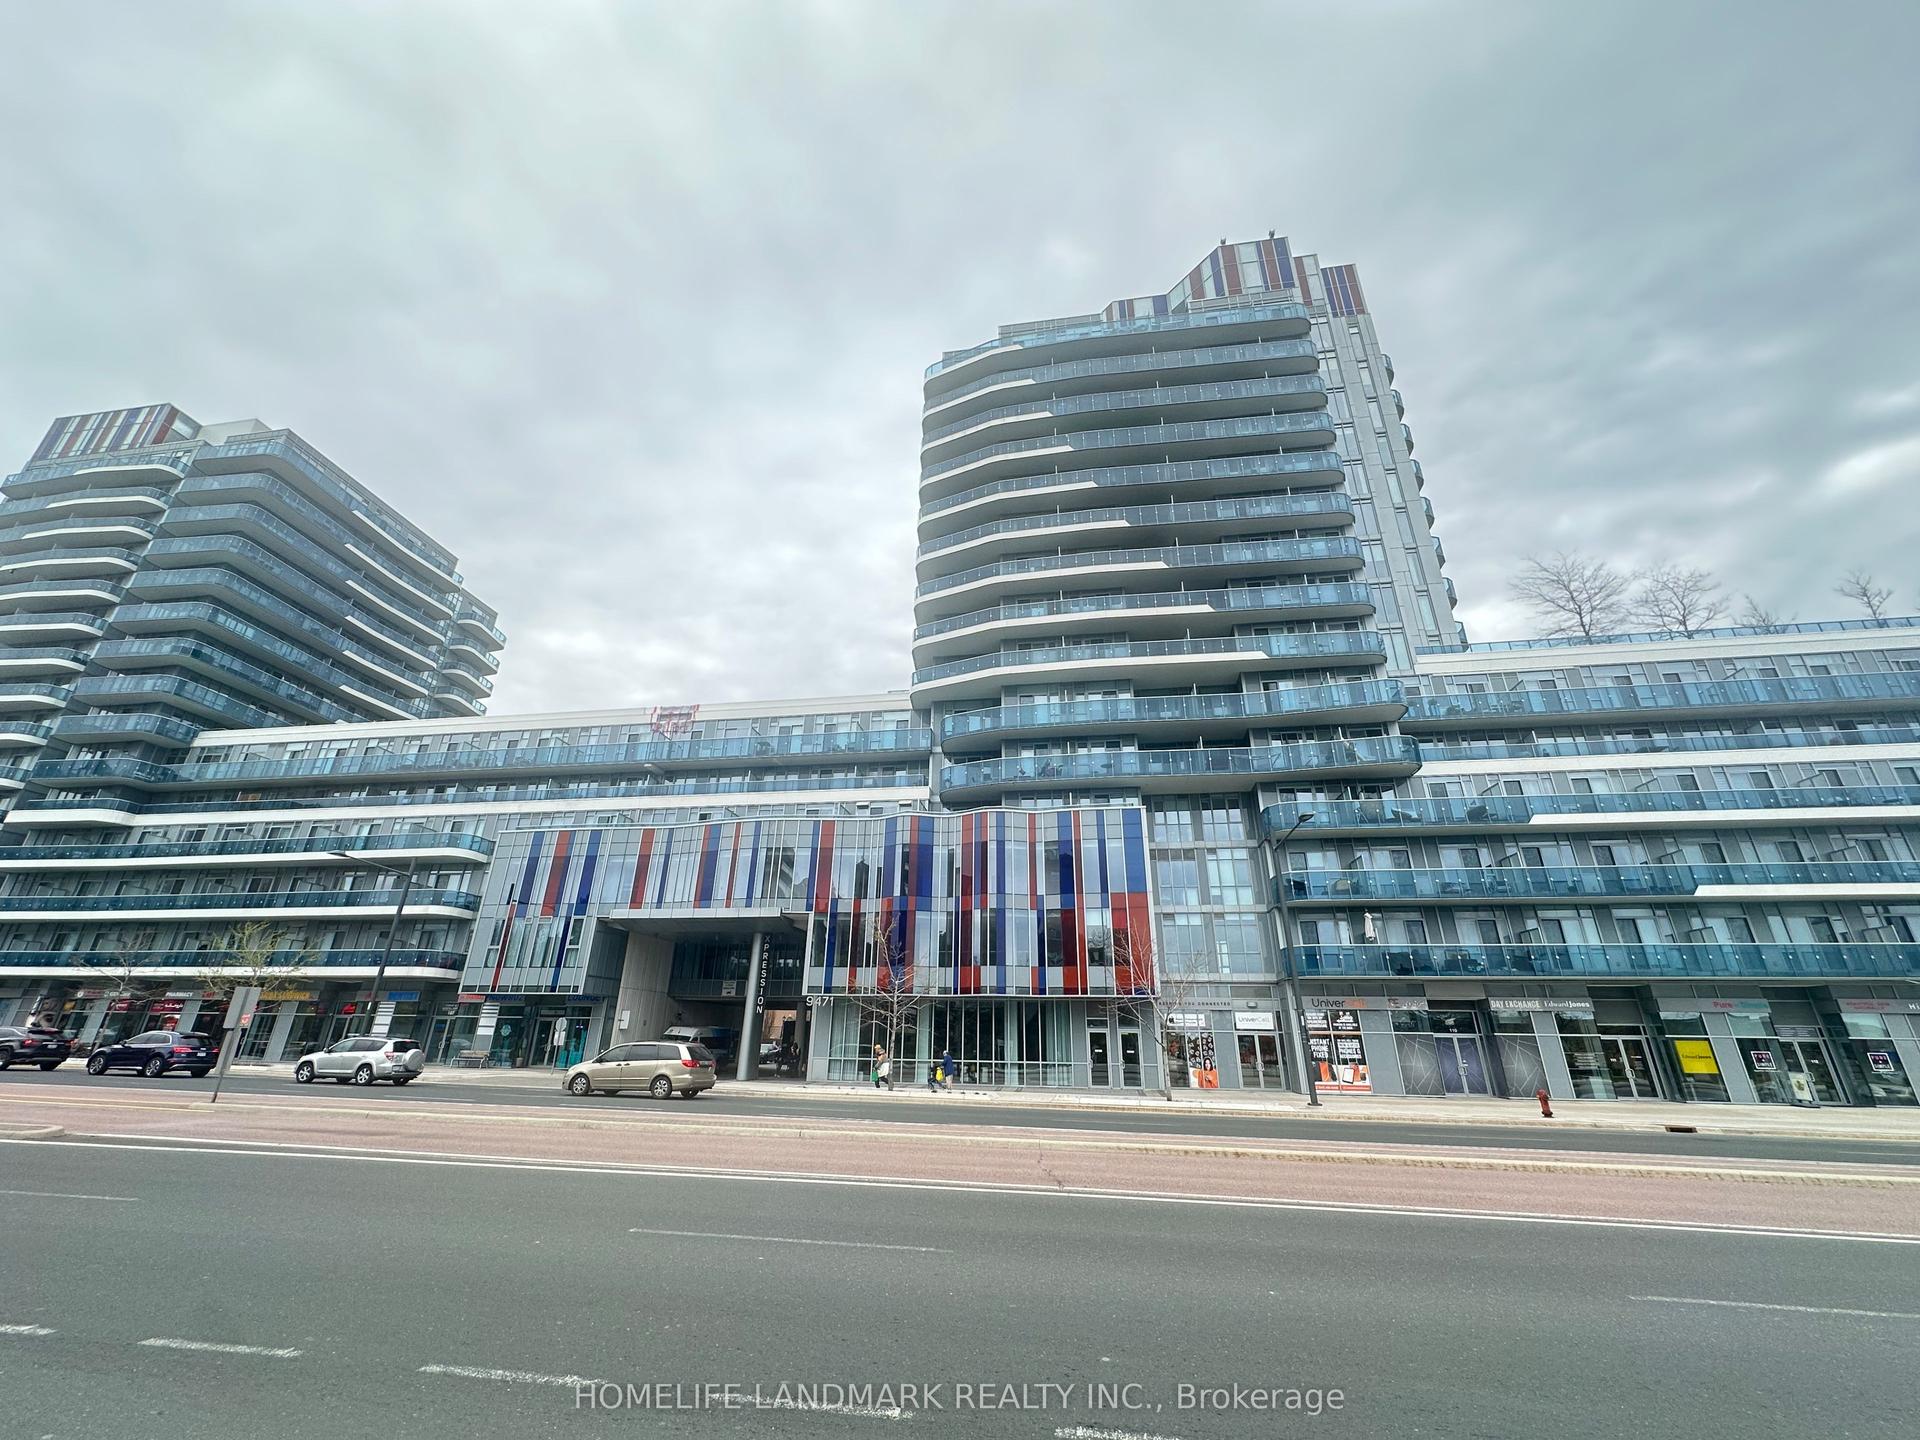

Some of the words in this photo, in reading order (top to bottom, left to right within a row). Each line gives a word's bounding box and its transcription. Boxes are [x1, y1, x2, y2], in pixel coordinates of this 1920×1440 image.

[756, 935, 771, 1014] XPRESSION
[806, 996, 834, 1007] 9471
[1505, 1000, 1540, 1009] EXCHANGE
[1313, 1051, 1329, 1059] FIXED
